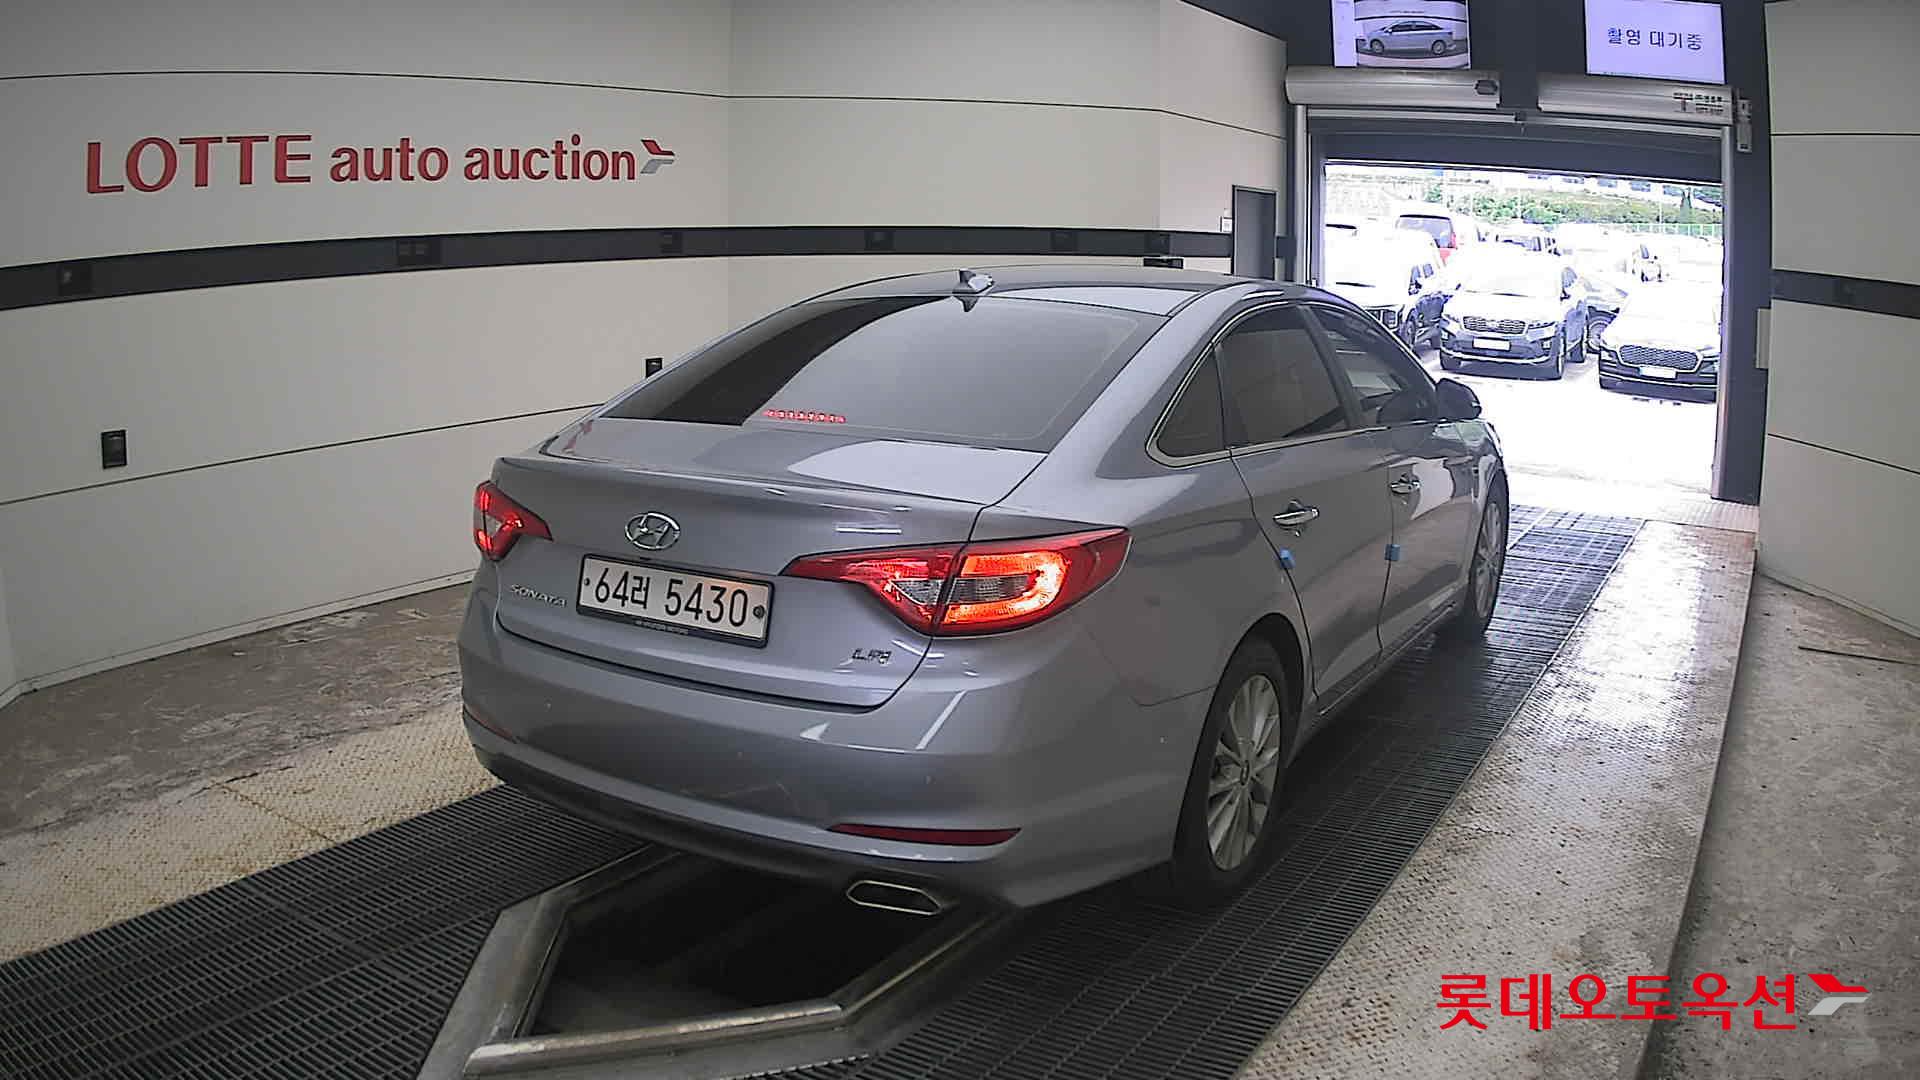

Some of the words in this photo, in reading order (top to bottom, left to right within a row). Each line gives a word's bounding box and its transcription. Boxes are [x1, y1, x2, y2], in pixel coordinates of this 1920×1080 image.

[87, 134, 312, 193] LOTTE
[329, 137, 449, 182] auto
[463, 133, 636, 181] auction
[594, 566, 650, 610] 64러
[664, 578, 749, 628] 5430
